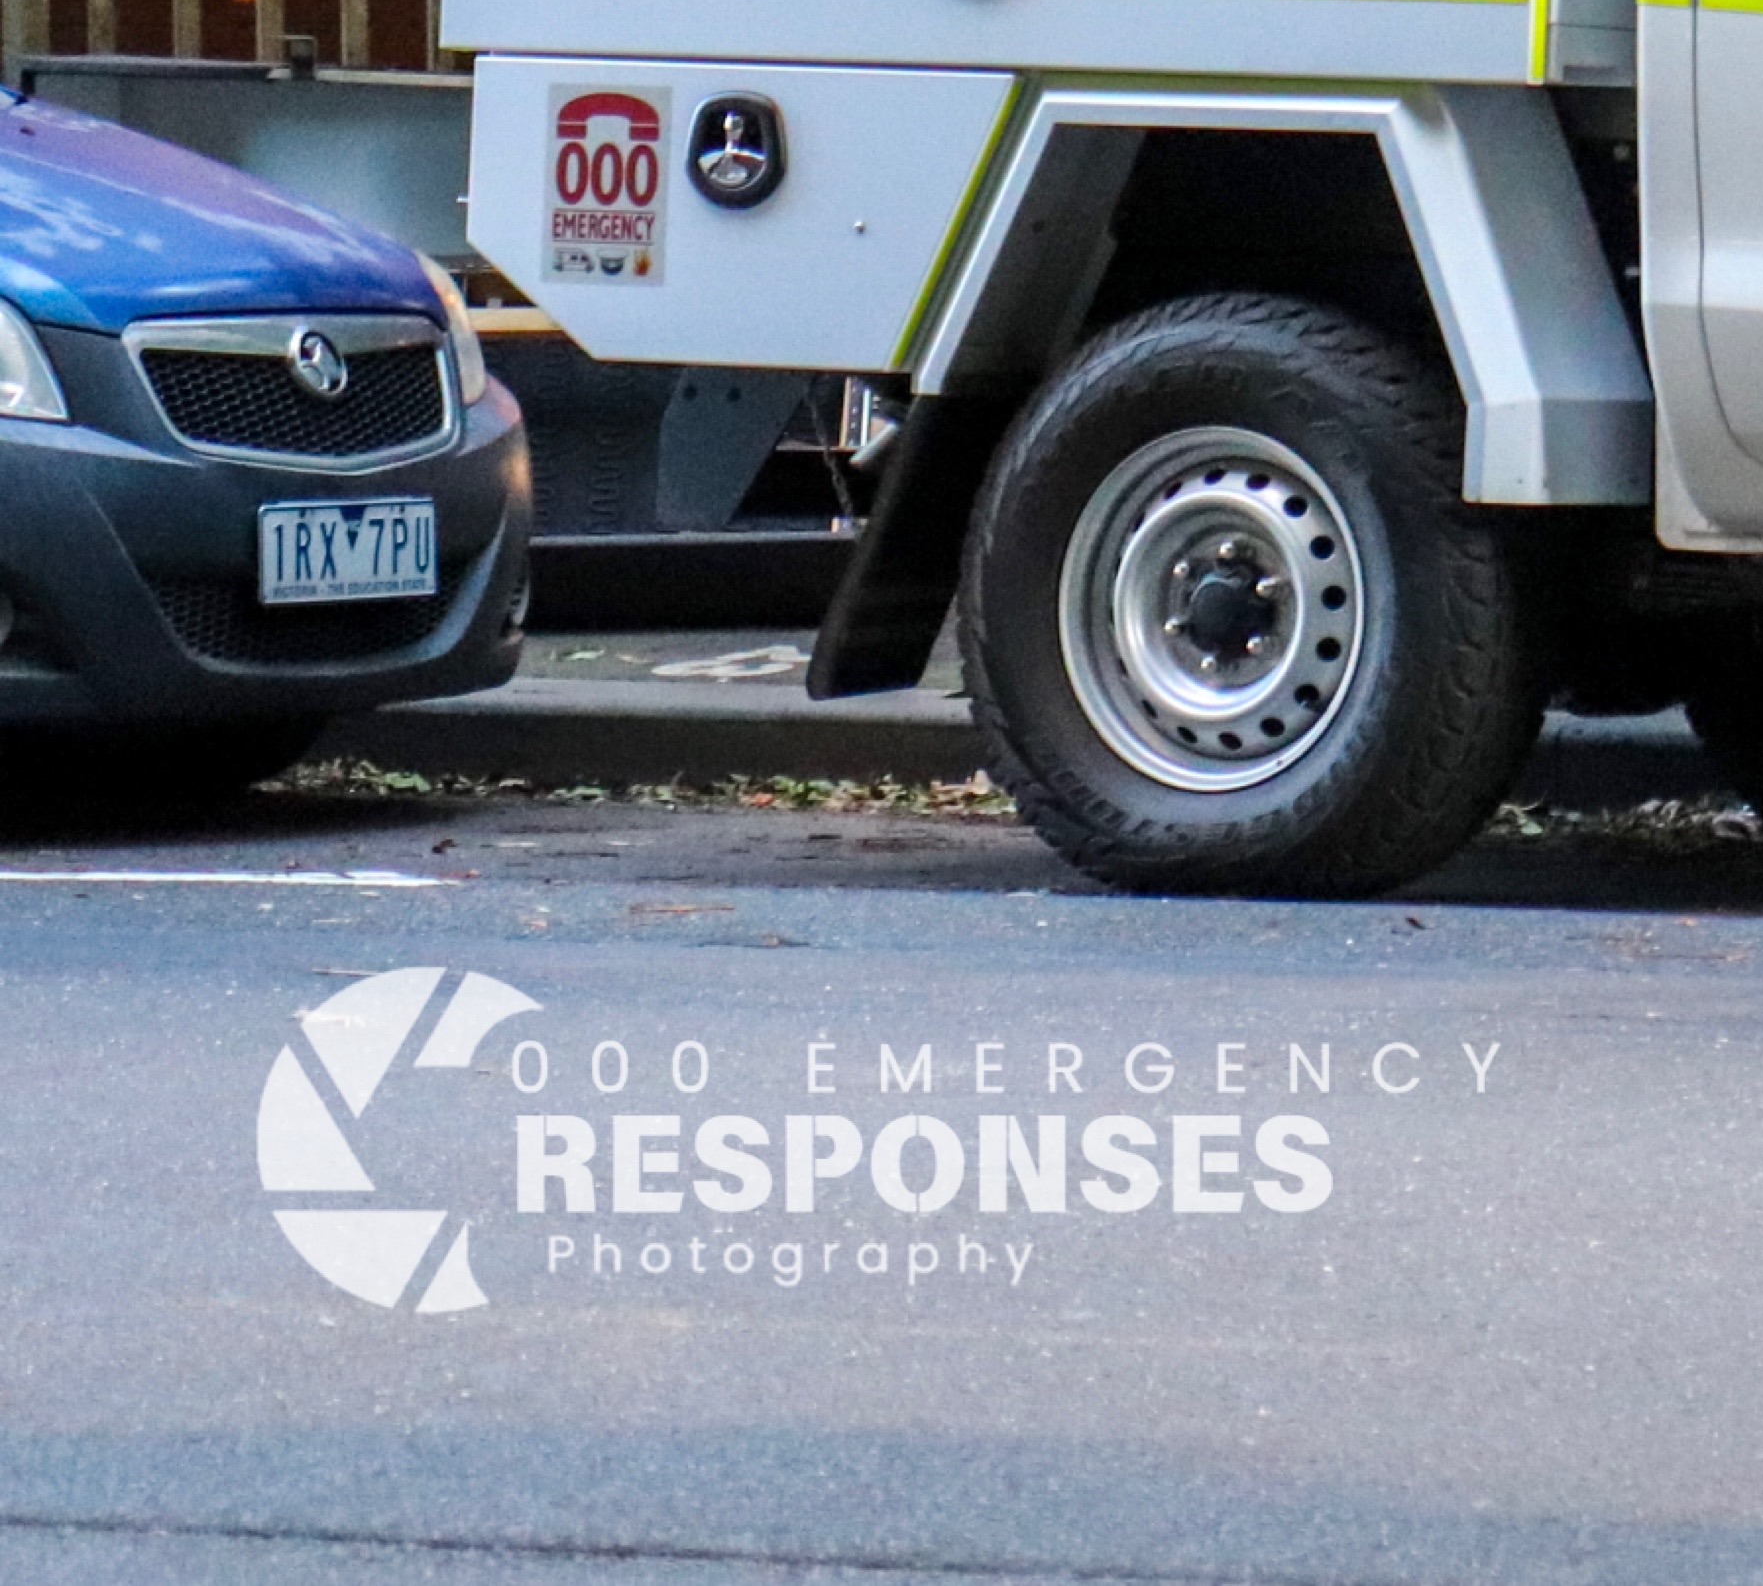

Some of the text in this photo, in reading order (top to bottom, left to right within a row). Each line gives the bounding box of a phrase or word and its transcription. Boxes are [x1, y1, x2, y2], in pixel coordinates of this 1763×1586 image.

[556, 142, 659, 206] 000
[553, 213, 654, 241] EMERGENCY
[274, 516, 430, 582] 1RX 7PU
